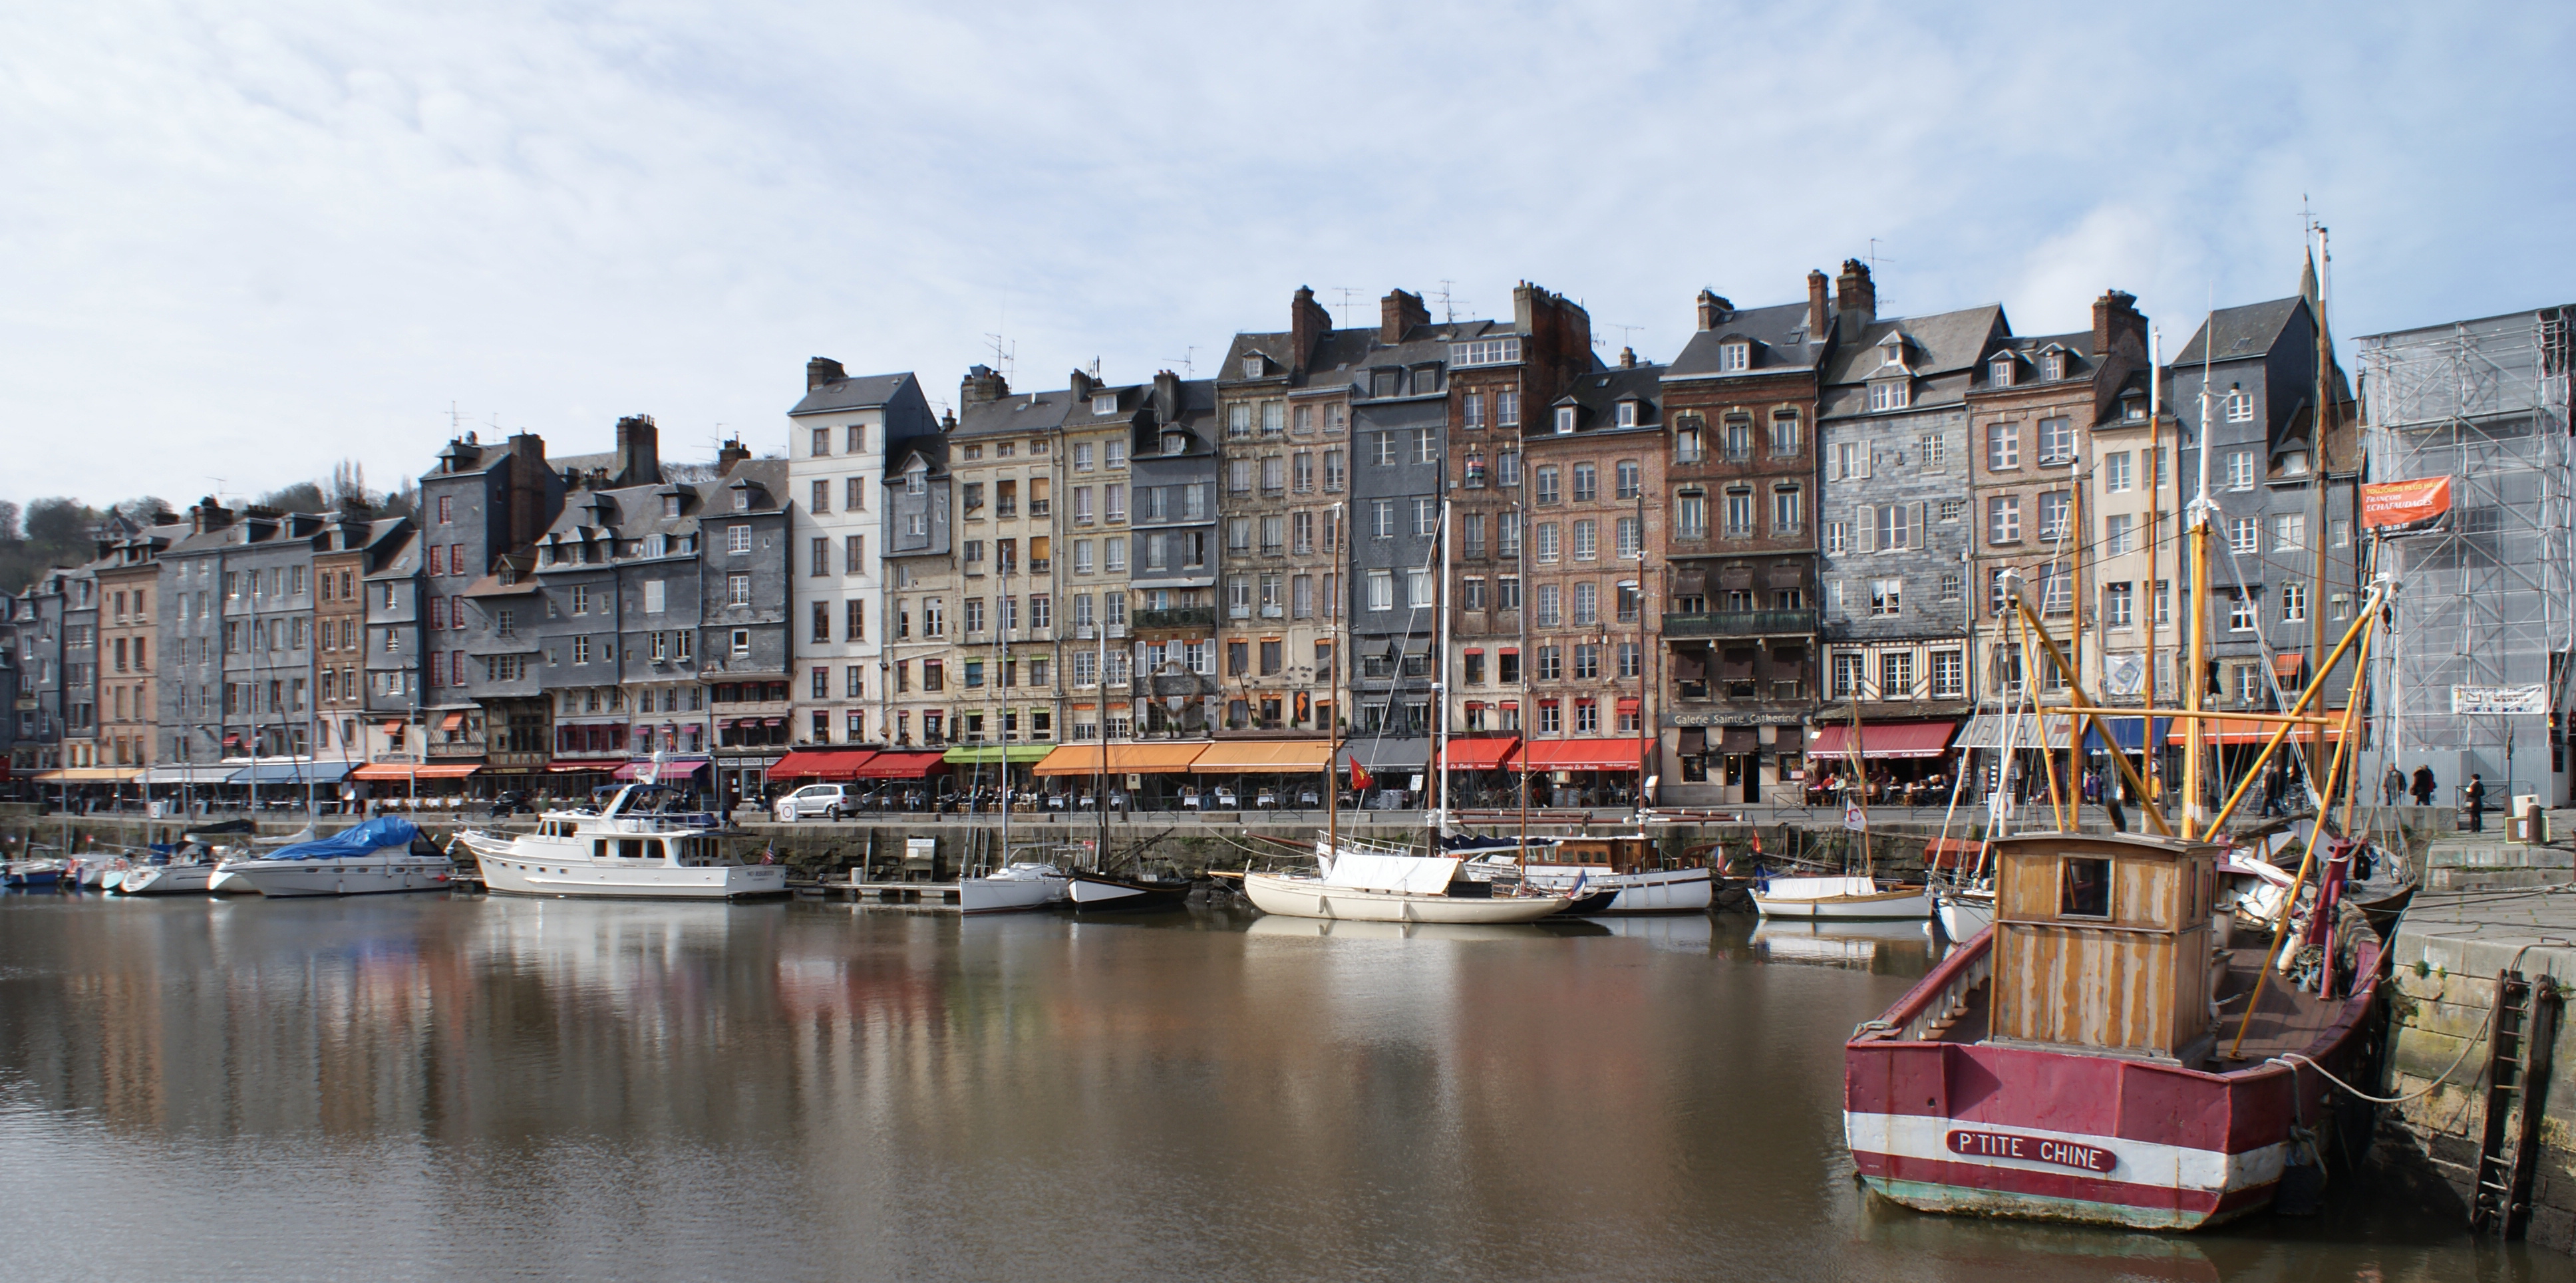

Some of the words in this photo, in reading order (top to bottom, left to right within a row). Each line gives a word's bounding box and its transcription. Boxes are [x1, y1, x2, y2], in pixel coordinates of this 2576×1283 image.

[2366, 486, 2402, 494] TOUJOURS
[2366, 494, 2402, 503] FRANÇOIS
[2366, 499, 2432, 511] ECHAFAUDAGES
[1674, 715, 1708, 724] Galerie
[1714, 714, 1744, 724] Sainte
[1749, 713, 1797, 723] Catherine
[1959, 1133, 2023, 1157] P'TITE
[2040, 1141, 2103, 1169] CHINE
